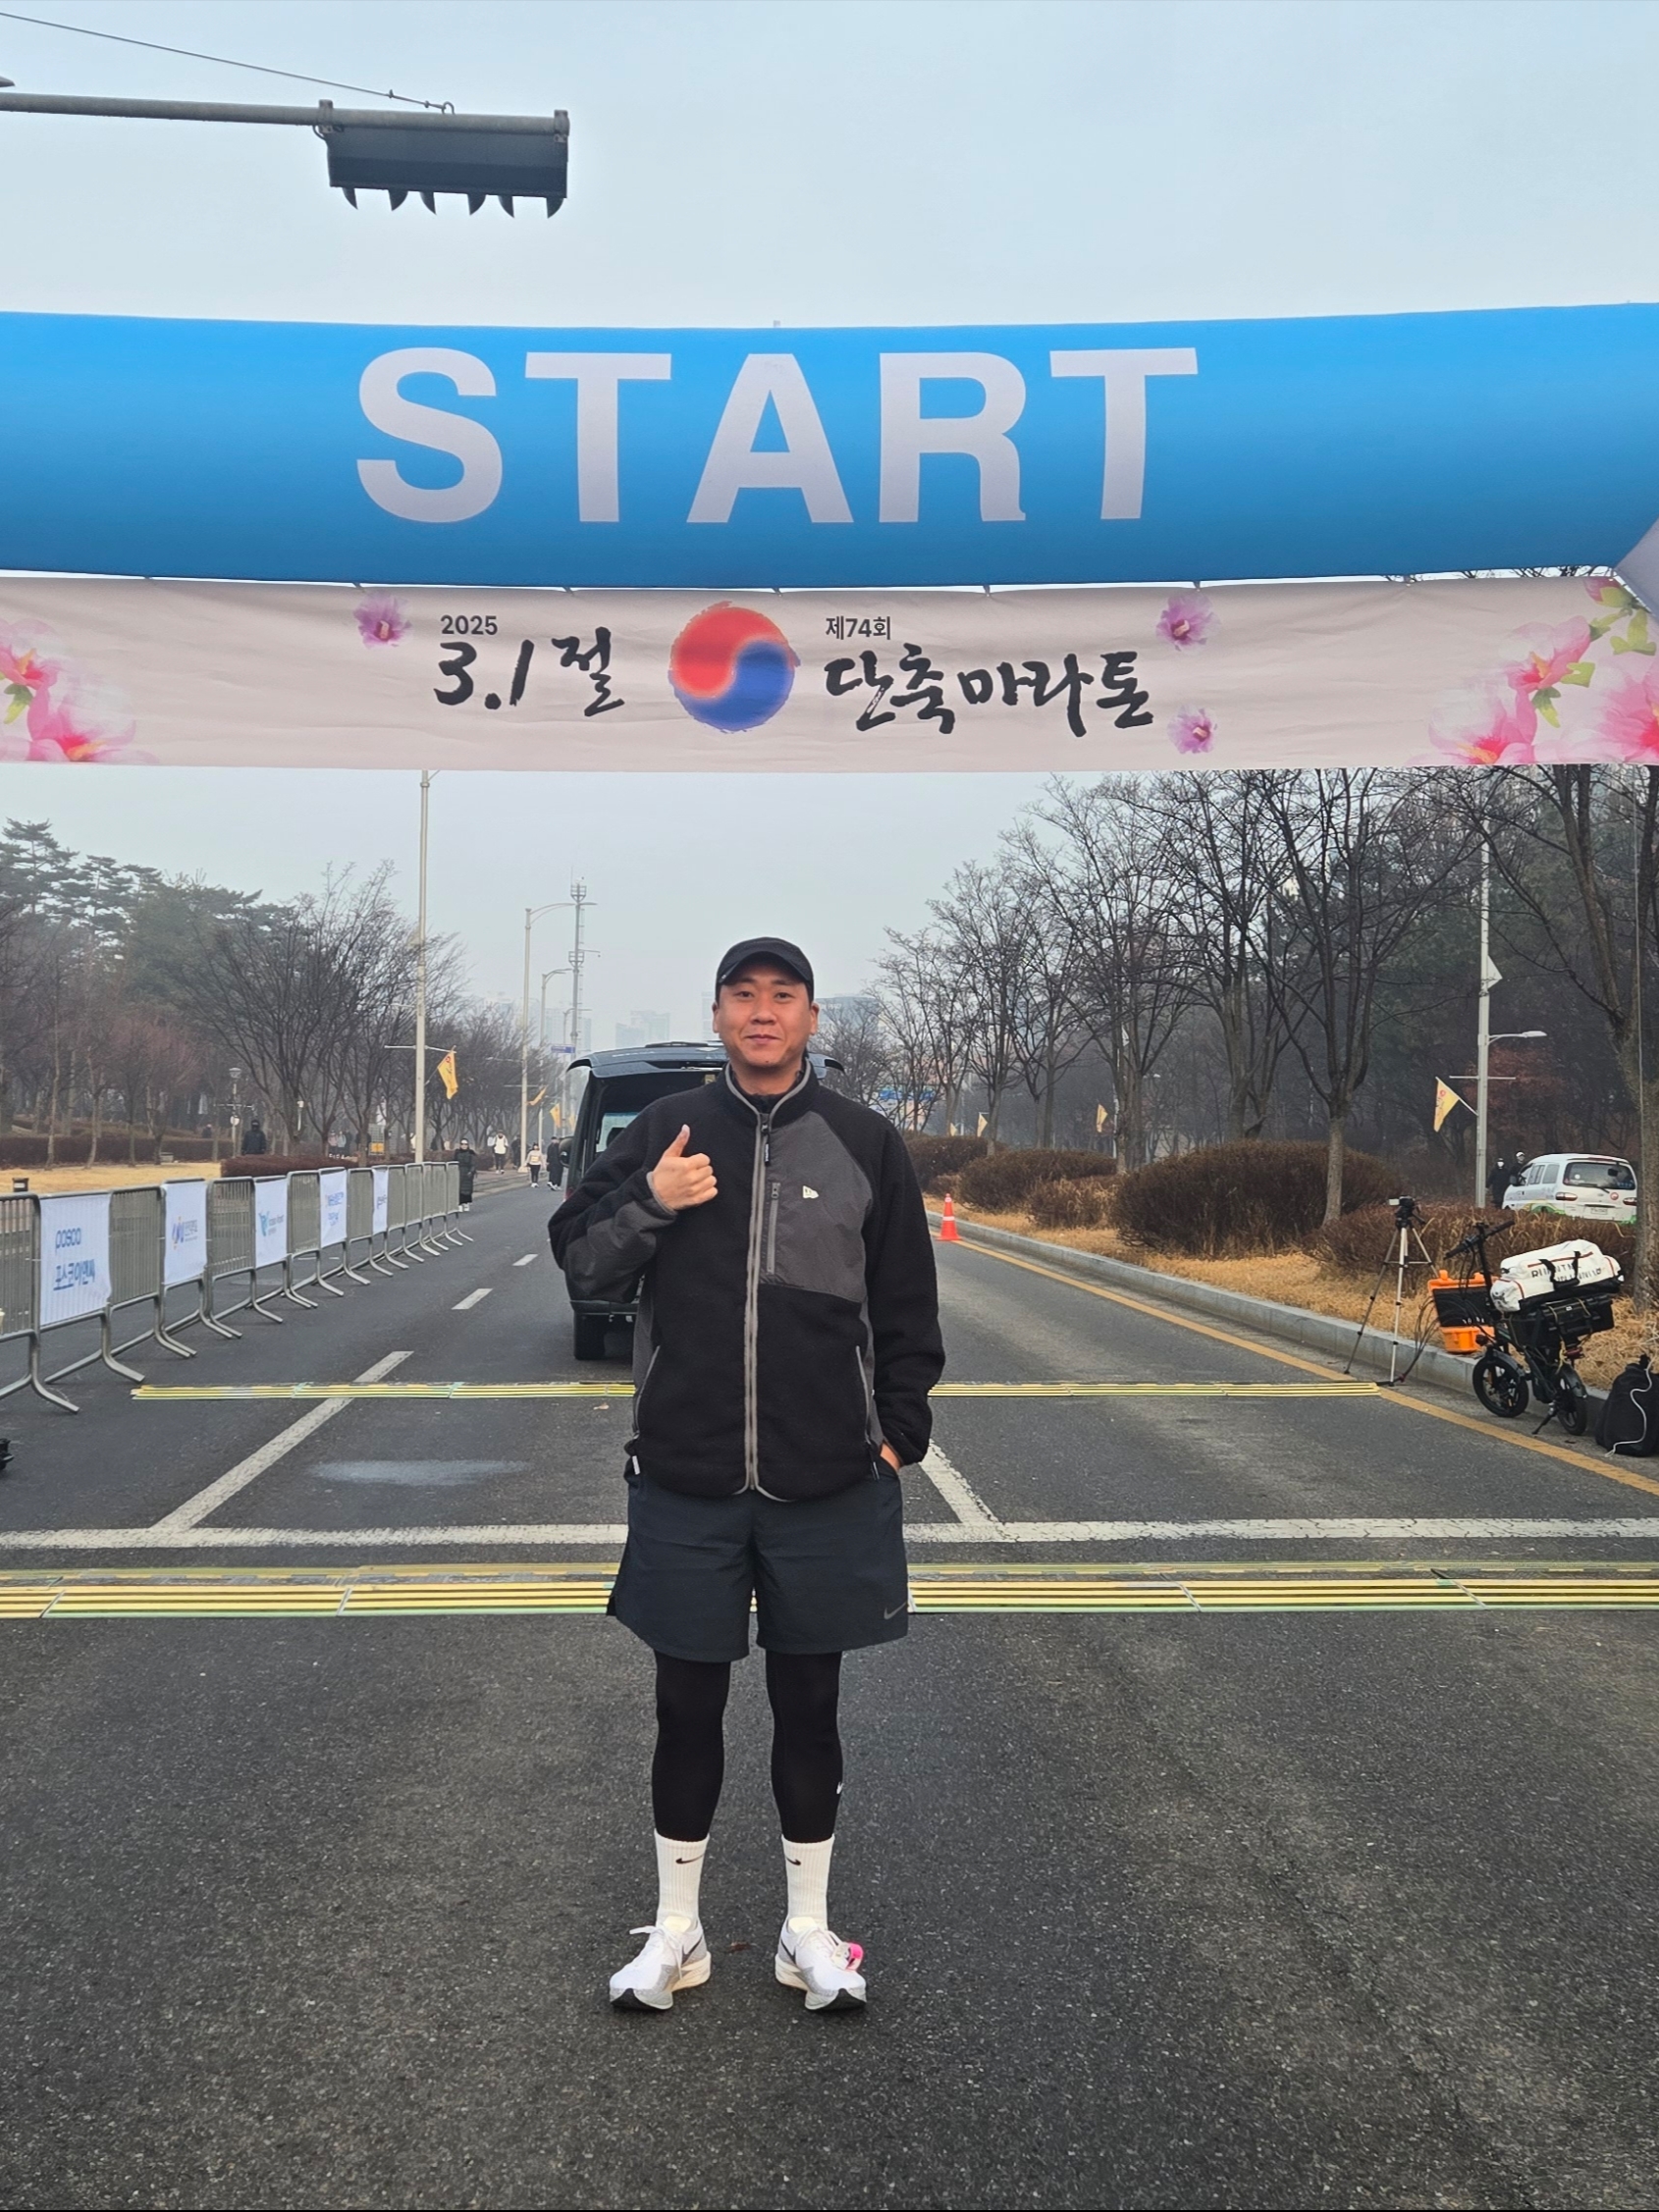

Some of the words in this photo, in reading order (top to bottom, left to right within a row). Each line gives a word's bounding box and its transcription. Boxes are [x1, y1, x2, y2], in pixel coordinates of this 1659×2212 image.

[356, 346, 1199, 524] START
[440, 614, 498, 636] 2025
[825, 615, 891, 641] 제74회
[433, 626, 625, 717] 3.1절
